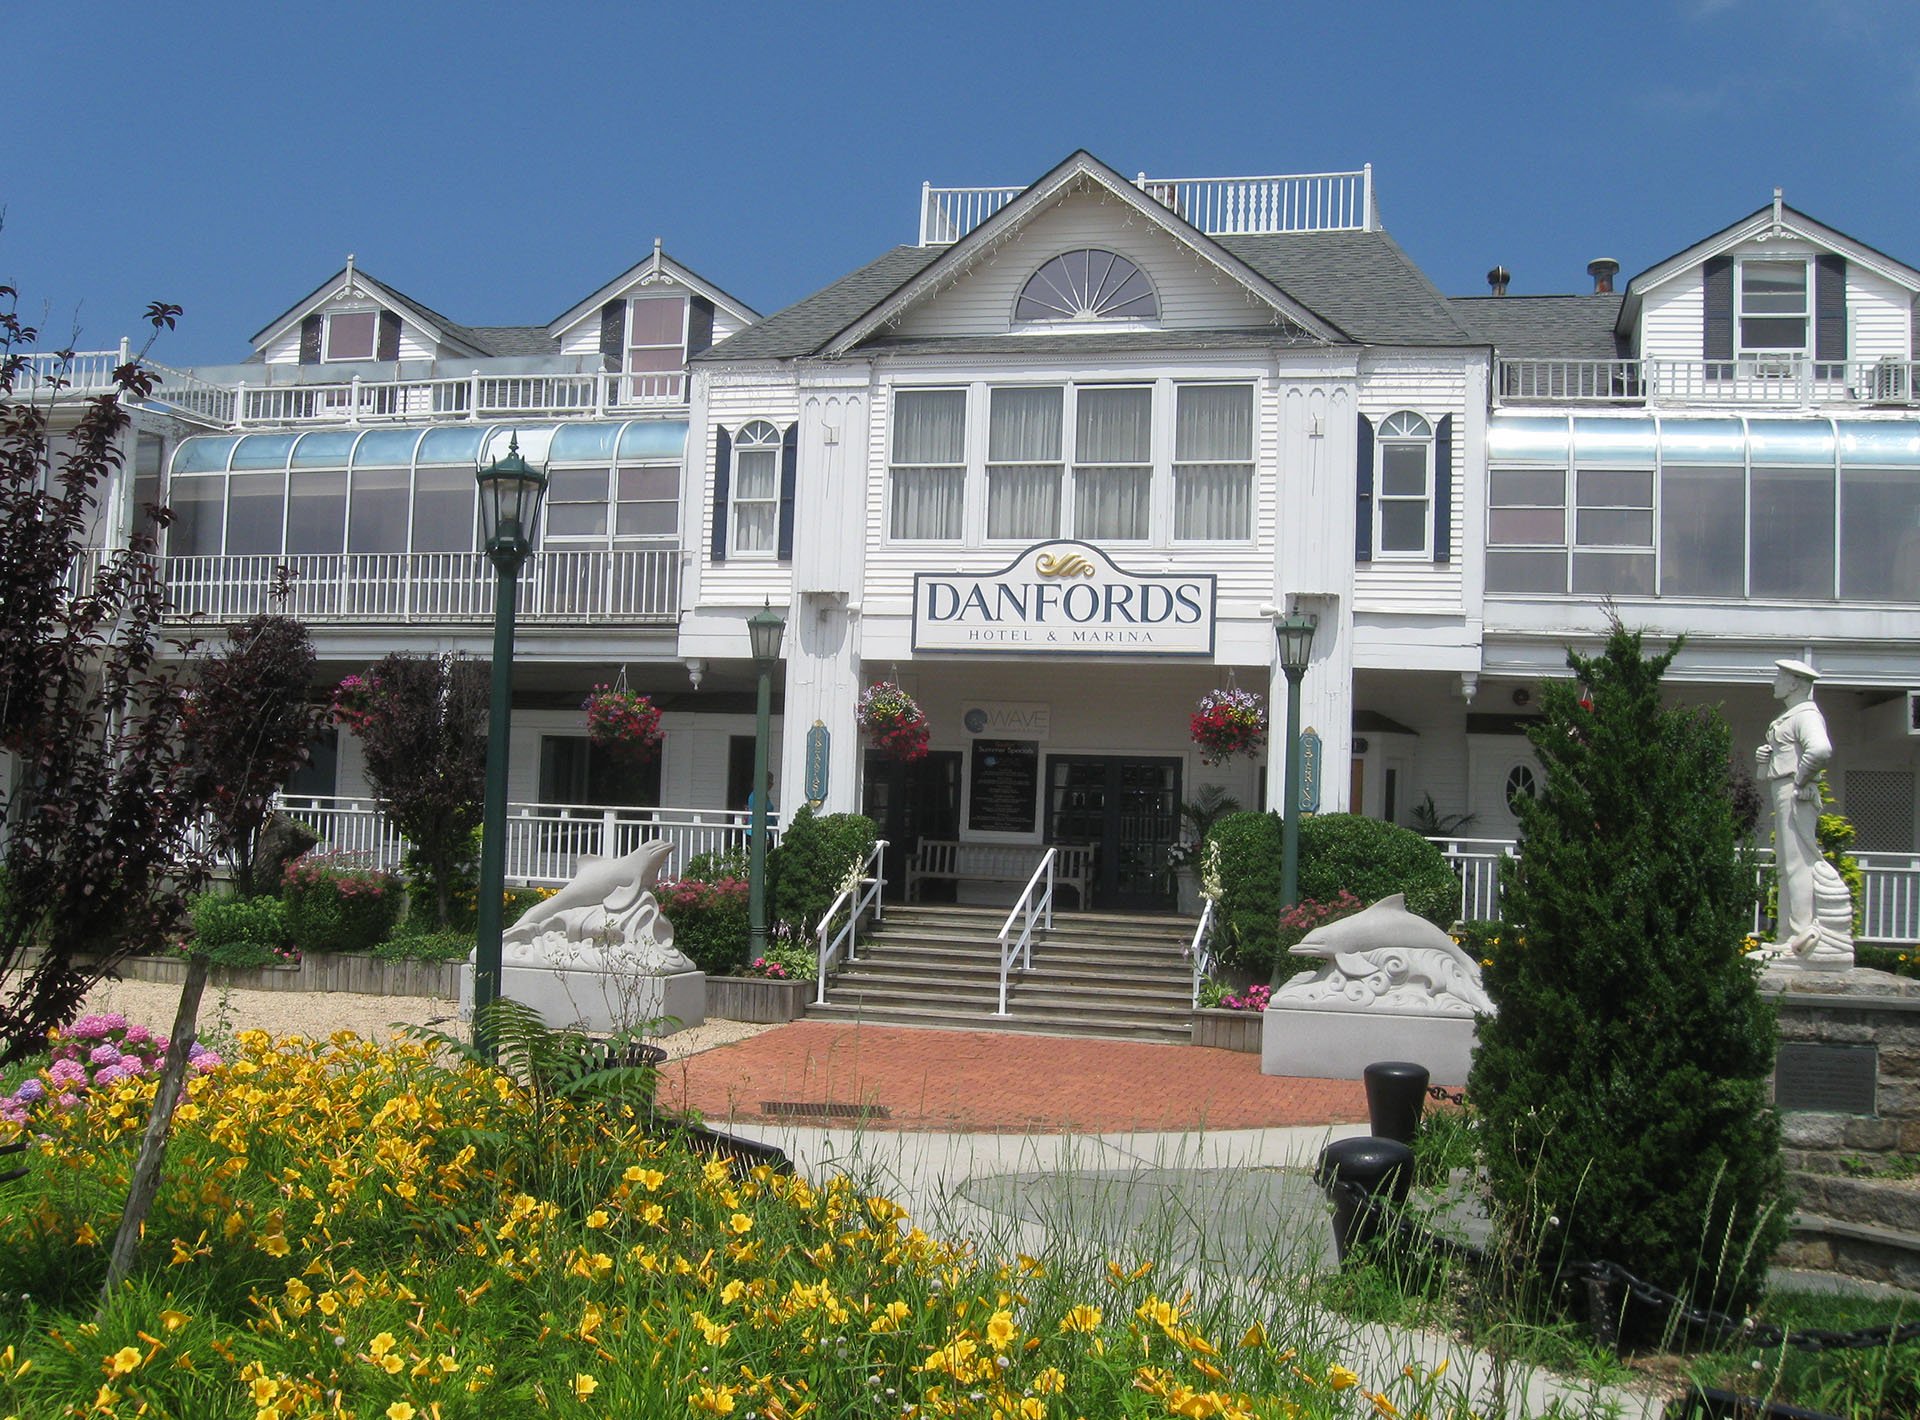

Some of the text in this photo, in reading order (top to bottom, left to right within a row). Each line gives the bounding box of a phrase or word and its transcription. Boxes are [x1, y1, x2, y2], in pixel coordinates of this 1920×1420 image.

[926, 582, 1202, 623] DANFORDS
[969, 630, 1153, 642] HOTEL & MARINA
[989, 710, 1048, 728] WAVE
